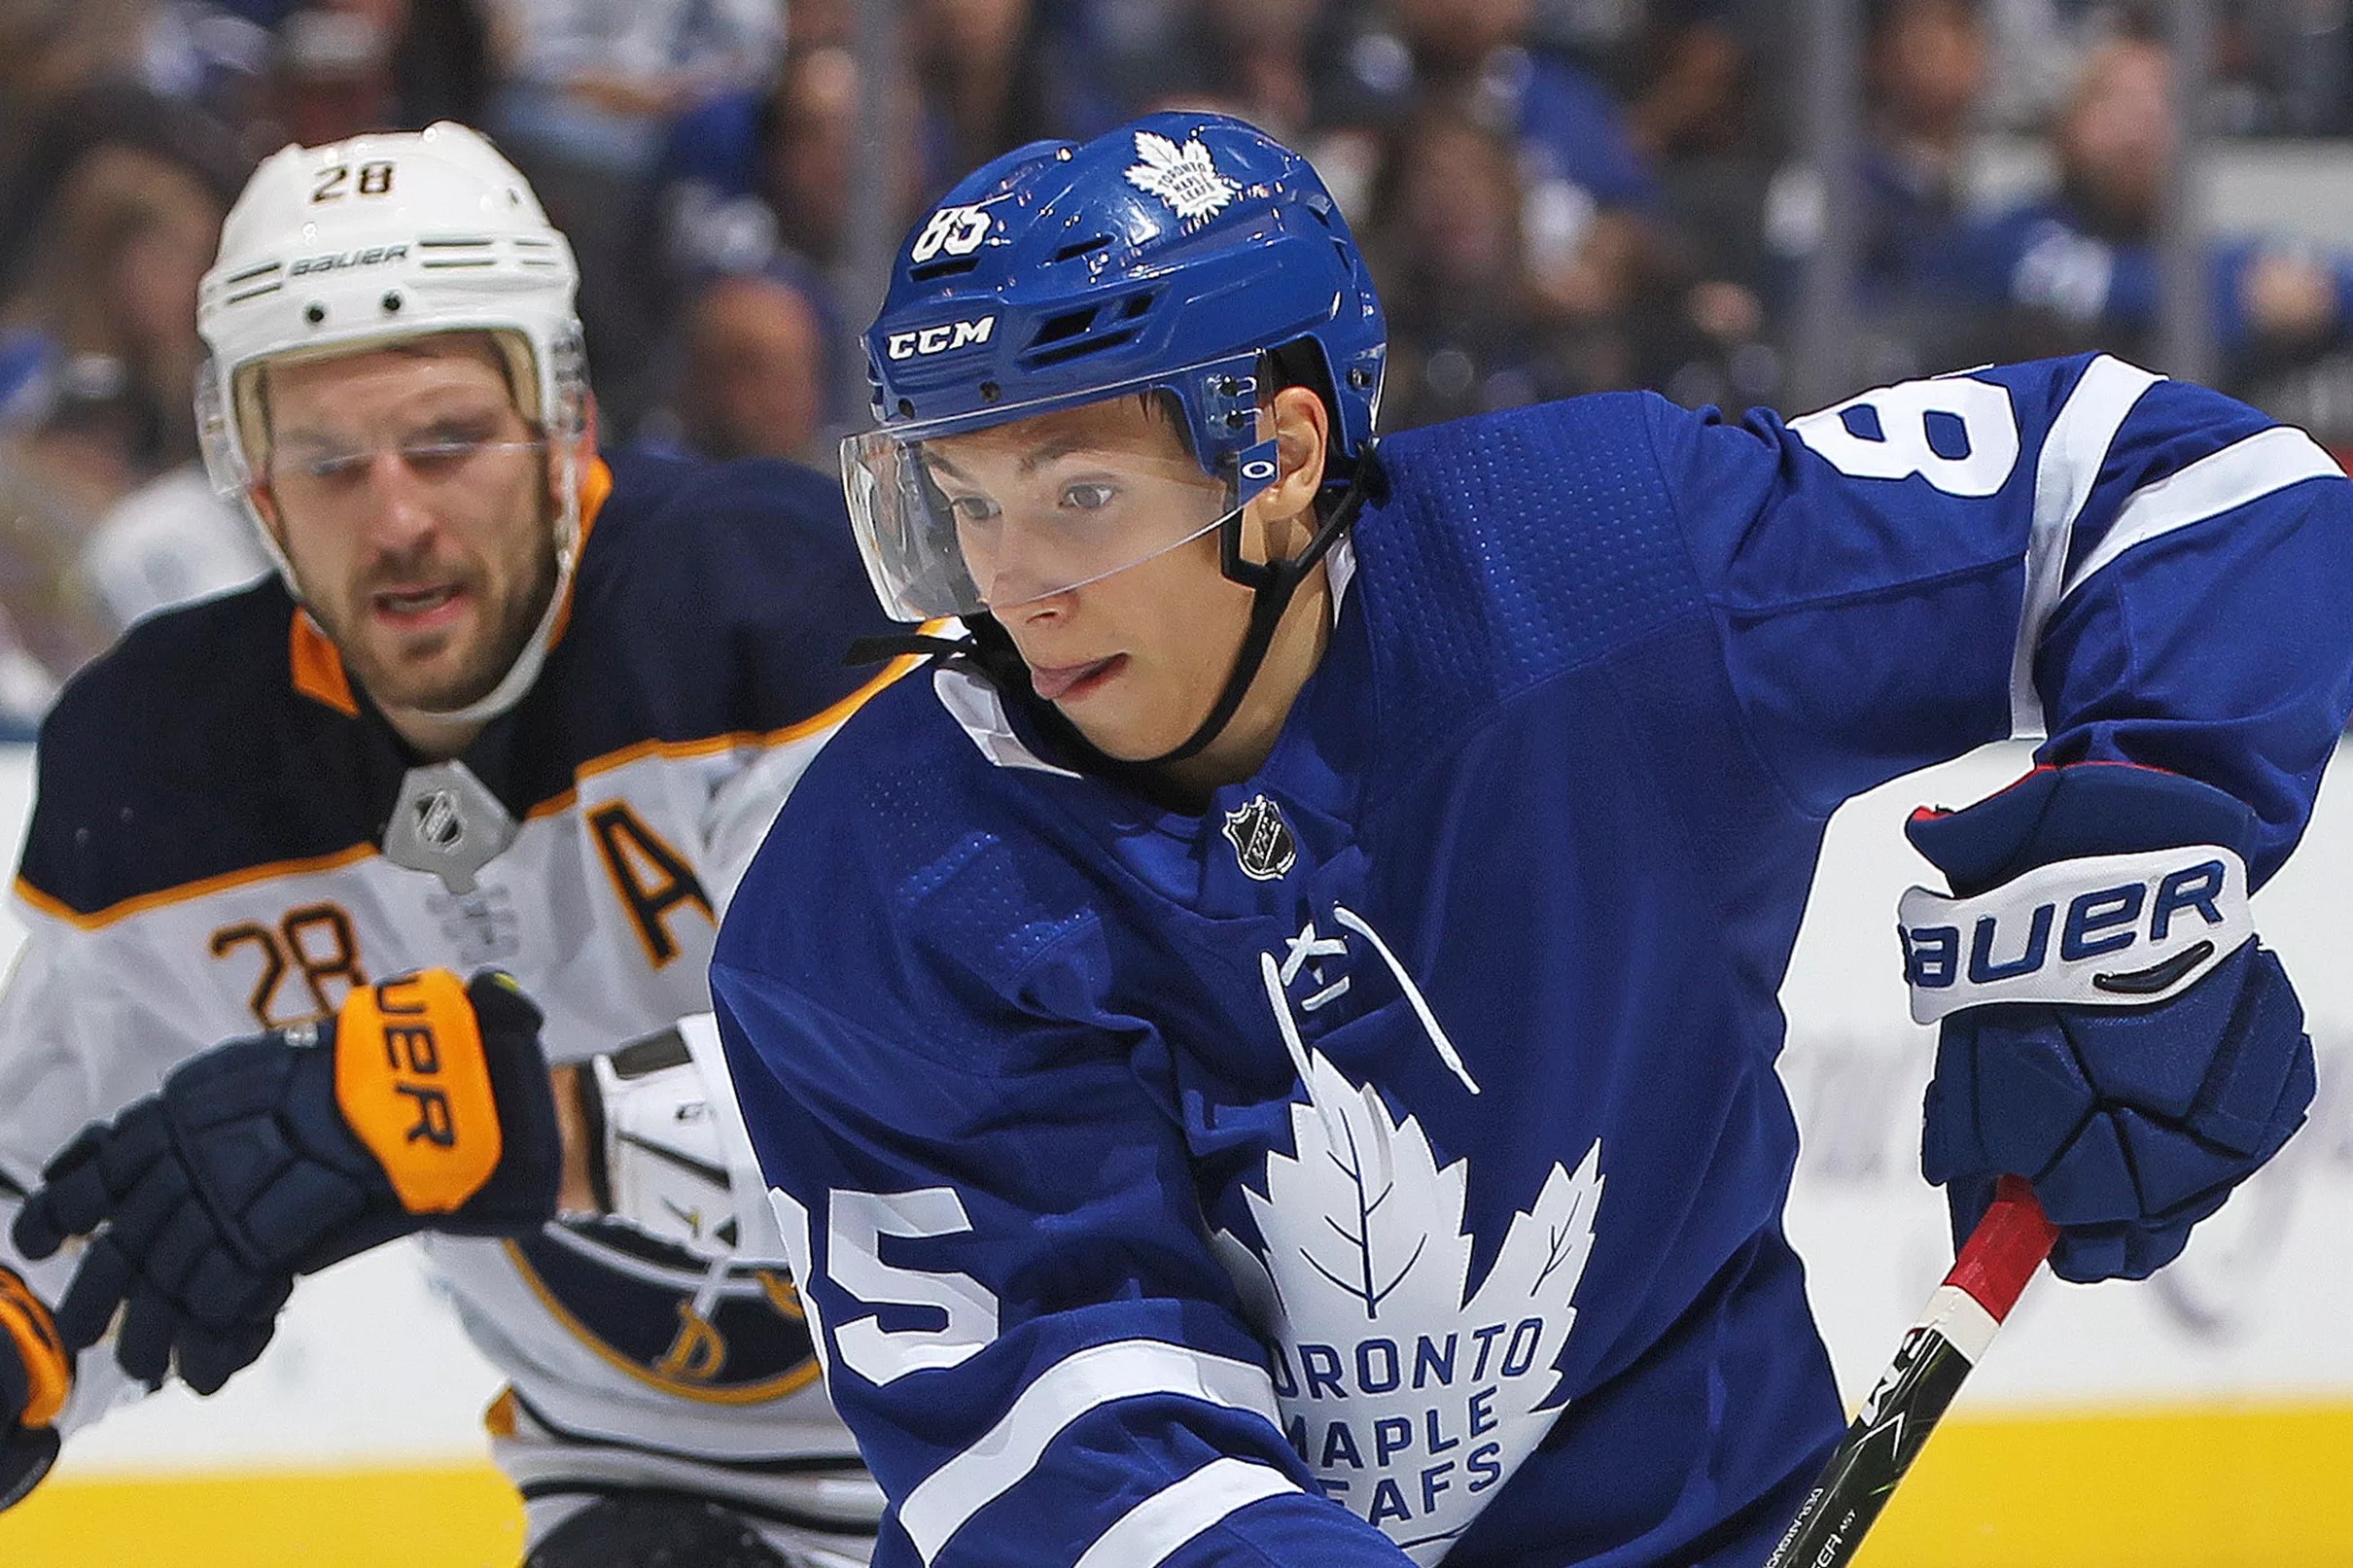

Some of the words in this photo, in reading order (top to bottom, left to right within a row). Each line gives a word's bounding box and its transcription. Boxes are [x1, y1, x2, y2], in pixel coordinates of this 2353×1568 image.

[312, 160, 398, 203] 28
[1157, 161, 1207, 189] TORONTO
[911, 206, 992, 263] 85
[887, 315, 995, 361] CCM
[1785, 363, 2021, 499] 8
[585, 798, 718, 970] A
[209, 900, 369, 1031] 28
[375, 973, 455, 1148] UER
[767, 1185, 1000, 1388] 5
[1270, 1316, 1544, 1401] ORONTO
